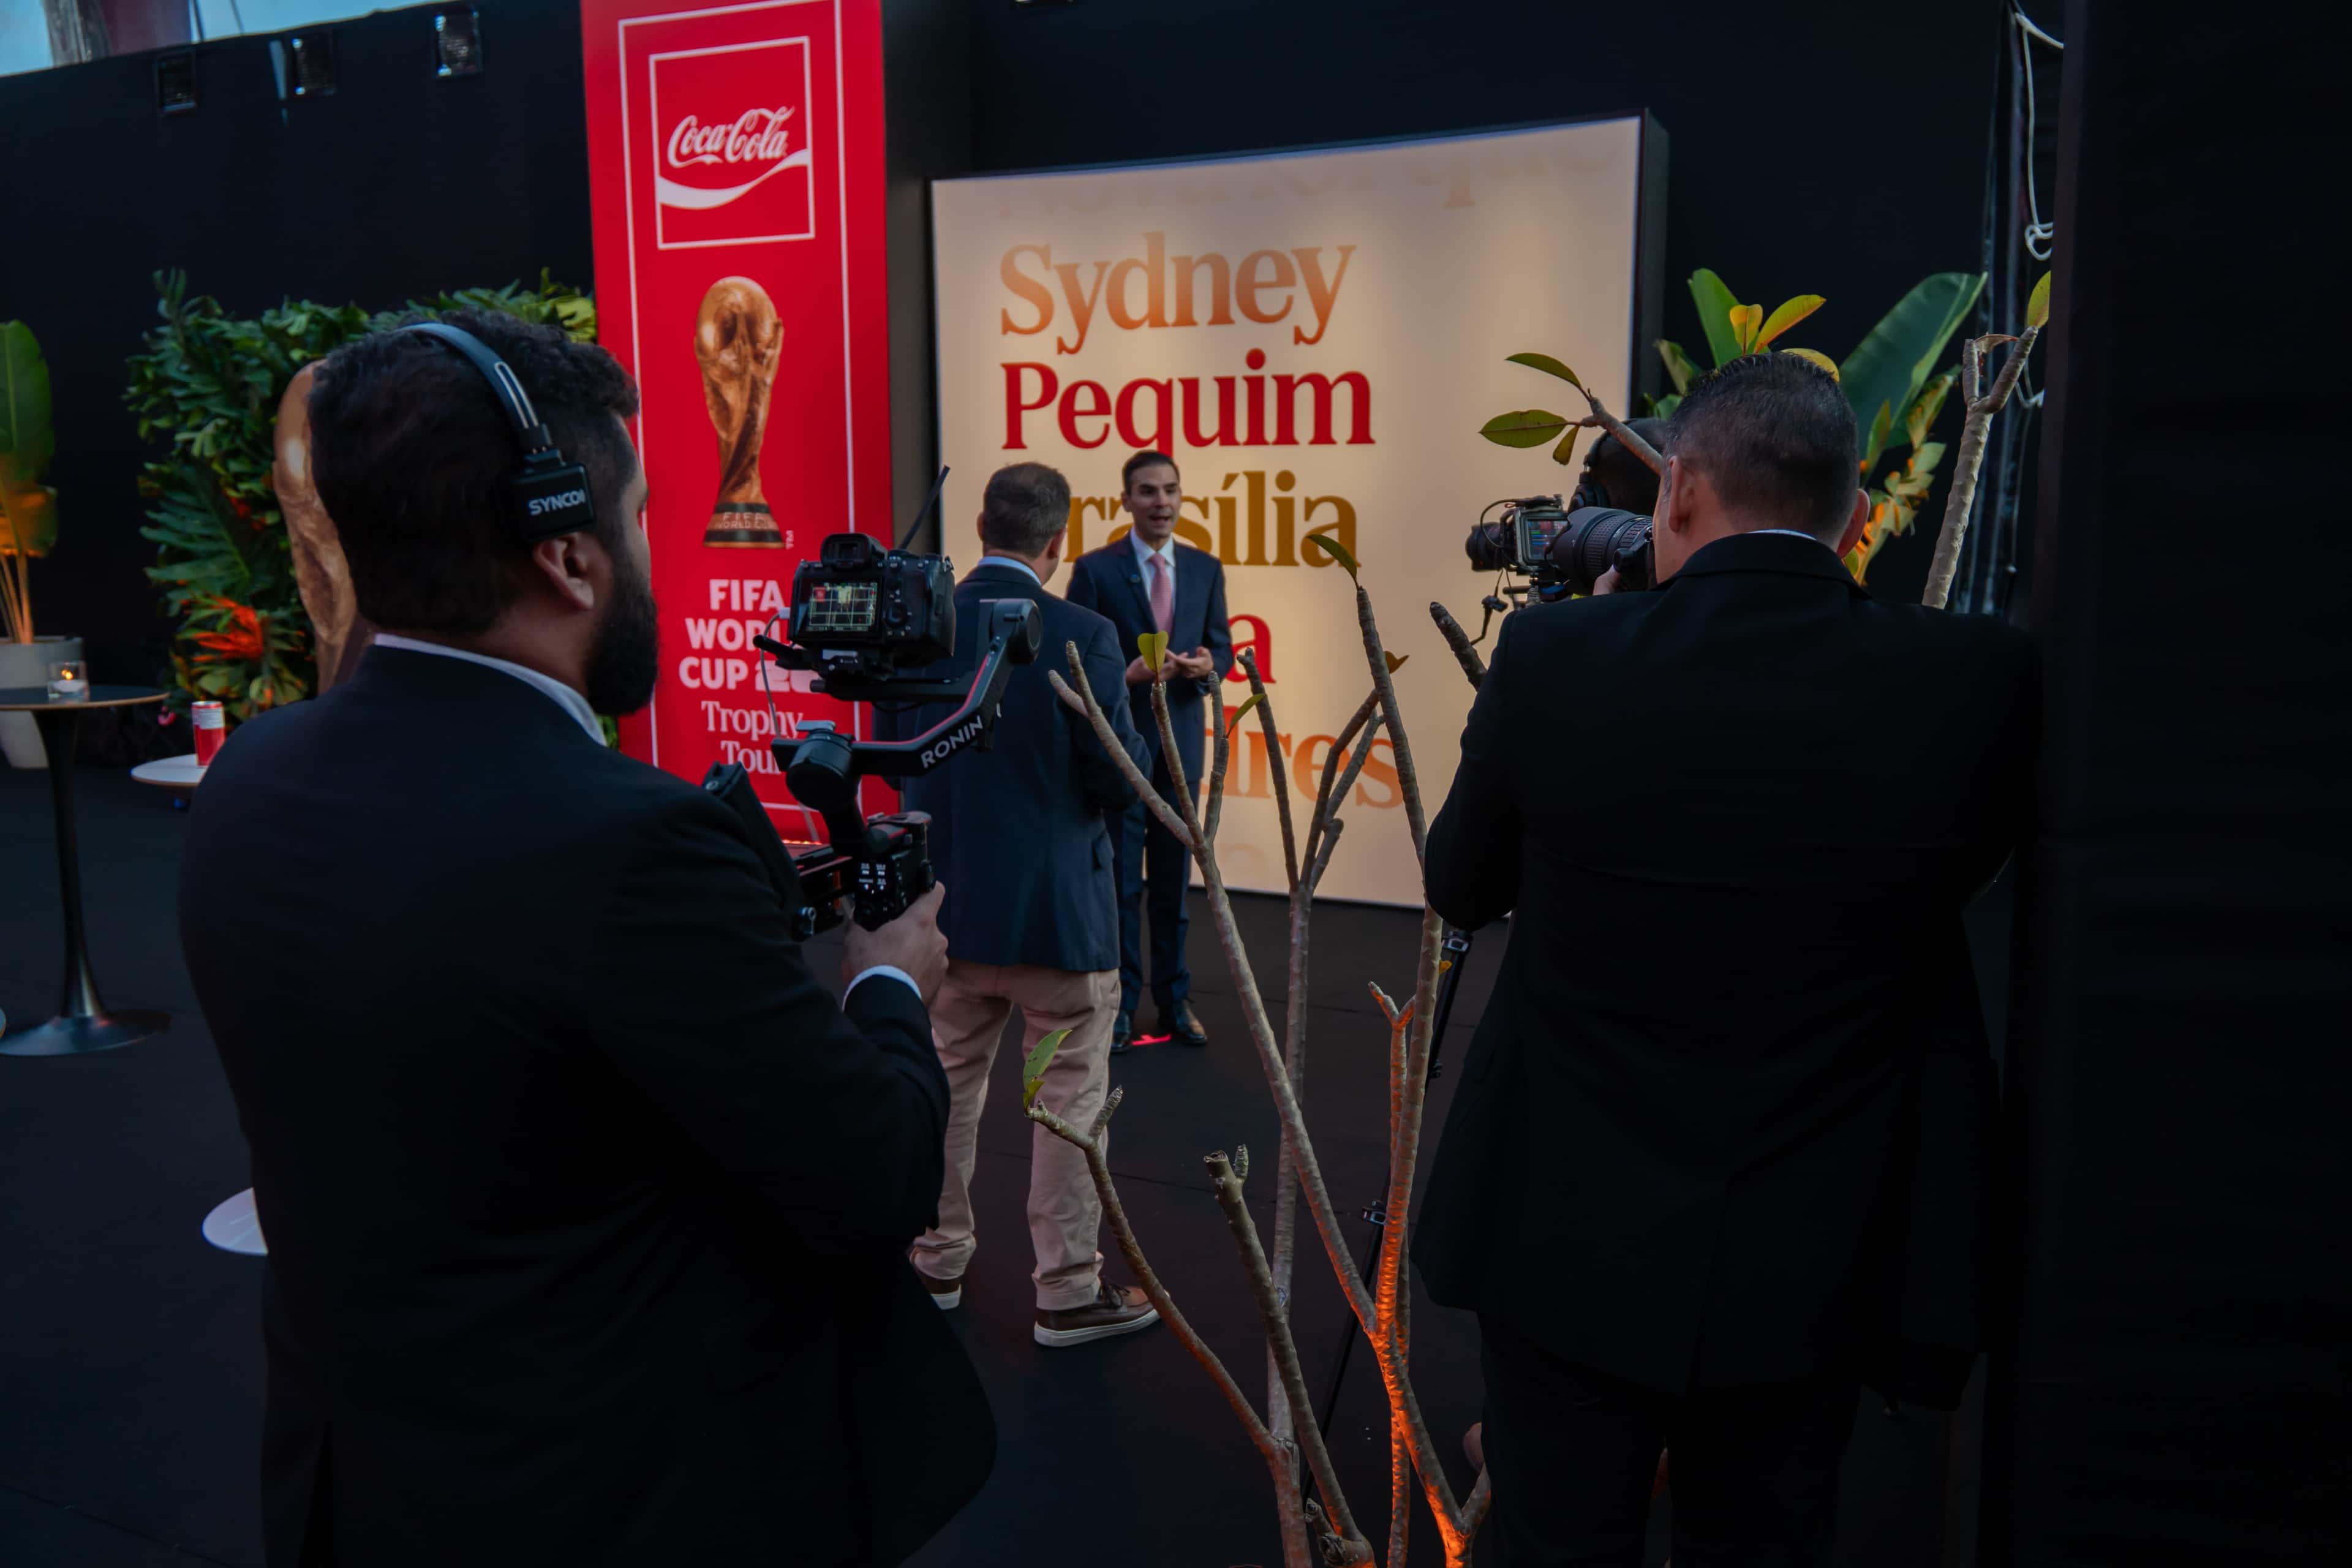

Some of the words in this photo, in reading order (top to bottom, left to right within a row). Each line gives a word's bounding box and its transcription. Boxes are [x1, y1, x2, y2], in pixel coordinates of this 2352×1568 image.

[1000, 232, 1357, 355] Sydney
[1000, 348, 1376, 456] Pequim
[709, 578, 790, 611] FIFA
[679, 657, 748, 690] CUP
[701, 700, 804, 742] Trophy
[720, 740, 782, 775] Tou
[921, 715, 984, 770] RONIN
